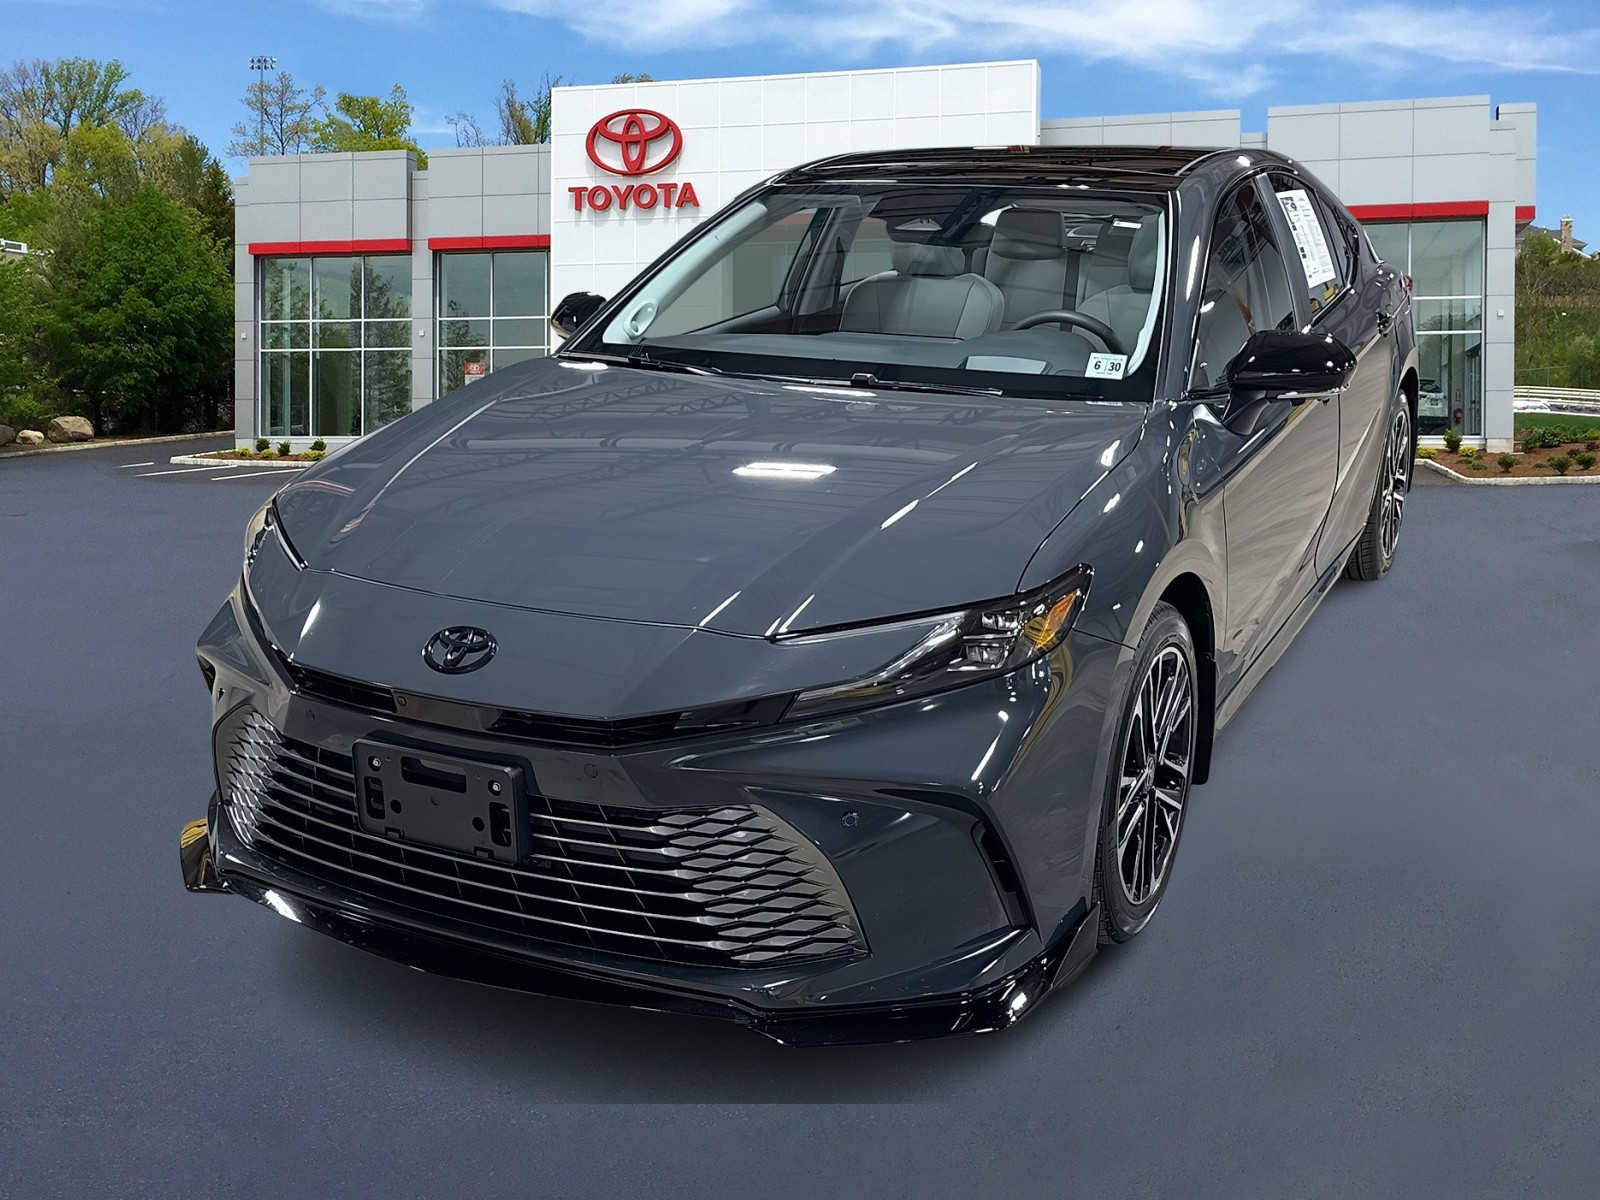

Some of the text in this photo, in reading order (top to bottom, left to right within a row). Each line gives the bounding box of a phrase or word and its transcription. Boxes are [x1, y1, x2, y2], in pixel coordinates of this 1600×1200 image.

[568, 182, 700, 211] TOYOTA
[1094, 360, 1121, 372] 6 30
